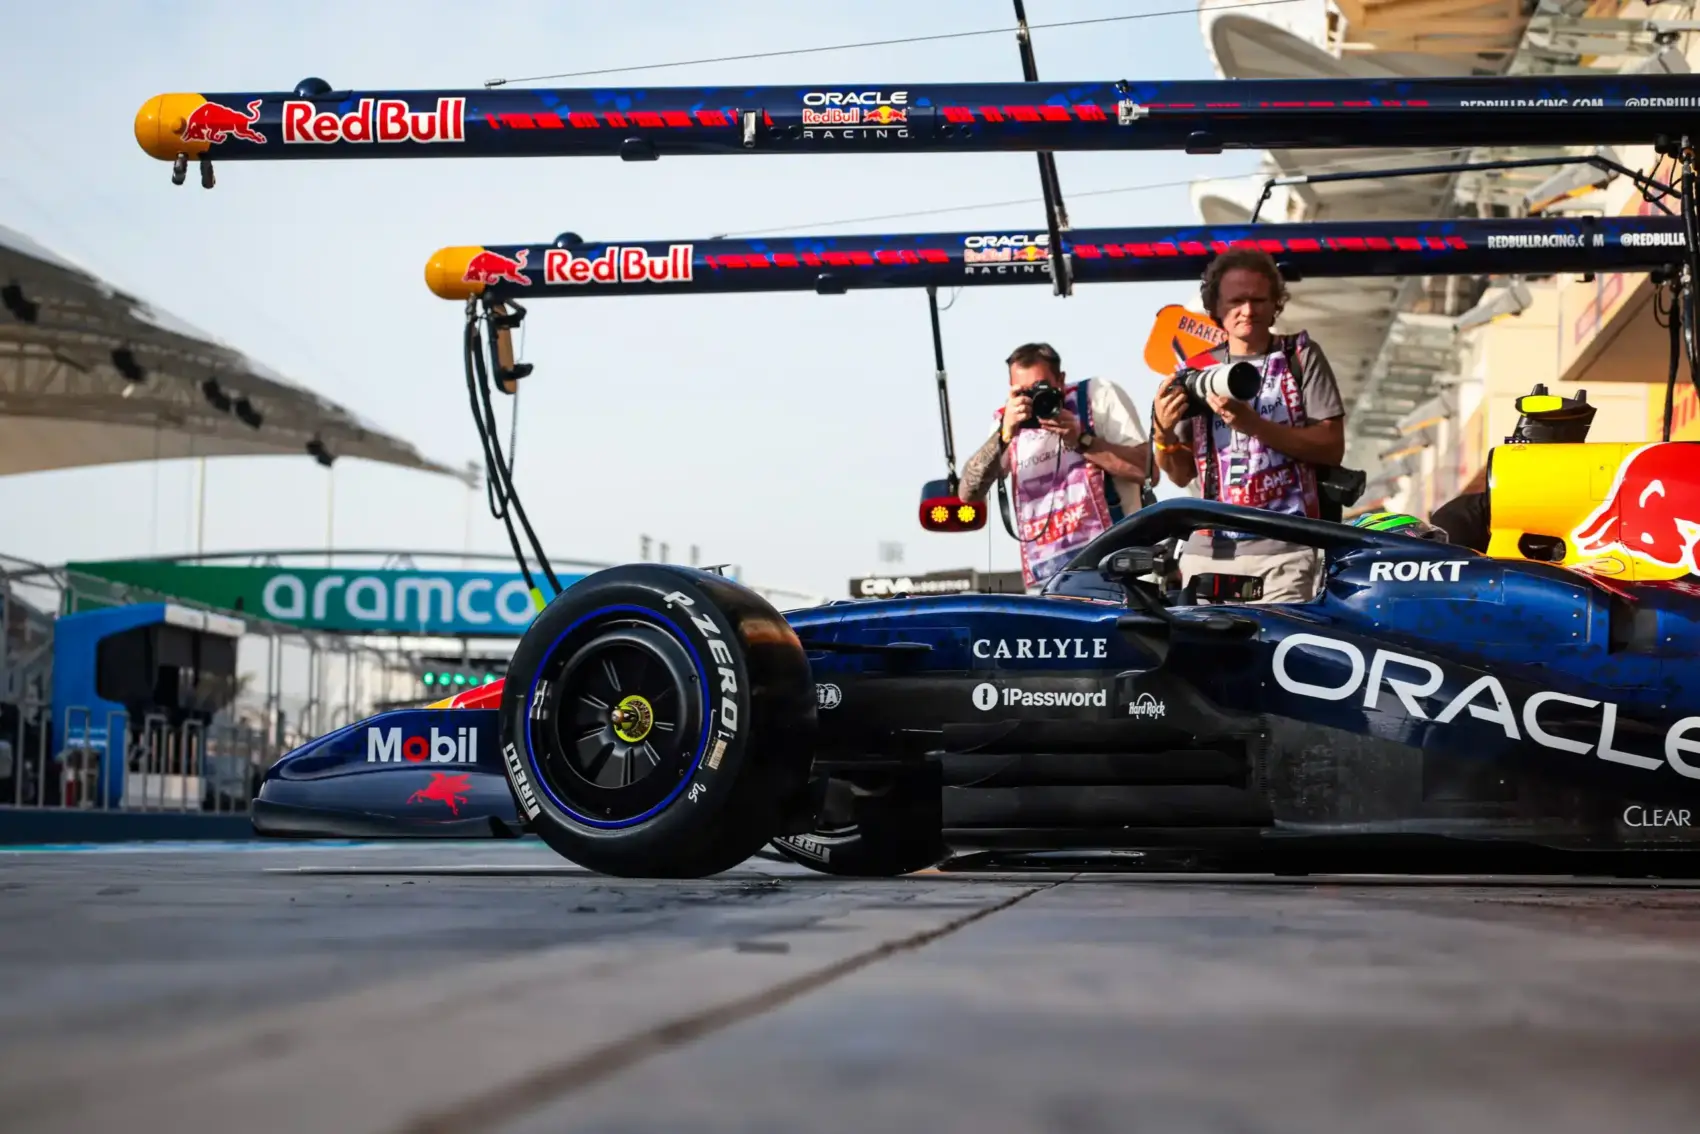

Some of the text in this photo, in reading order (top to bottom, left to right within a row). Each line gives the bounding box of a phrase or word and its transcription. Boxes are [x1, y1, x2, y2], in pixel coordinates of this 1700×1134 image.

[803, 91, 909, 106] ORACLE
[282, 96, 467, 144] Red Bull
[802, 107, 861, 124] Red Bull
[803, 129, 909, 139] RACING
[964, 234, 1050, 248] ORACLE
[1487, 233, 1605, 249] REDBULLRACING.CM
[544, 244, 695, 285] Red Bull
[1369, 561, 1469, 582] ROKT
[262, 573, 538, 626] aramco
[973, 638, 1108, 659] CARLYLE
[691, 613, 738, 732] ZERO
[1002, 688, 1107, 707] 1Password
[1129, 700, 1165, 717] Hard Rock
[367, 727, 478, 763] Mobil
[502, 742, 541, 821] PIRELLI
[773, 835, 832, 864] PIRE
